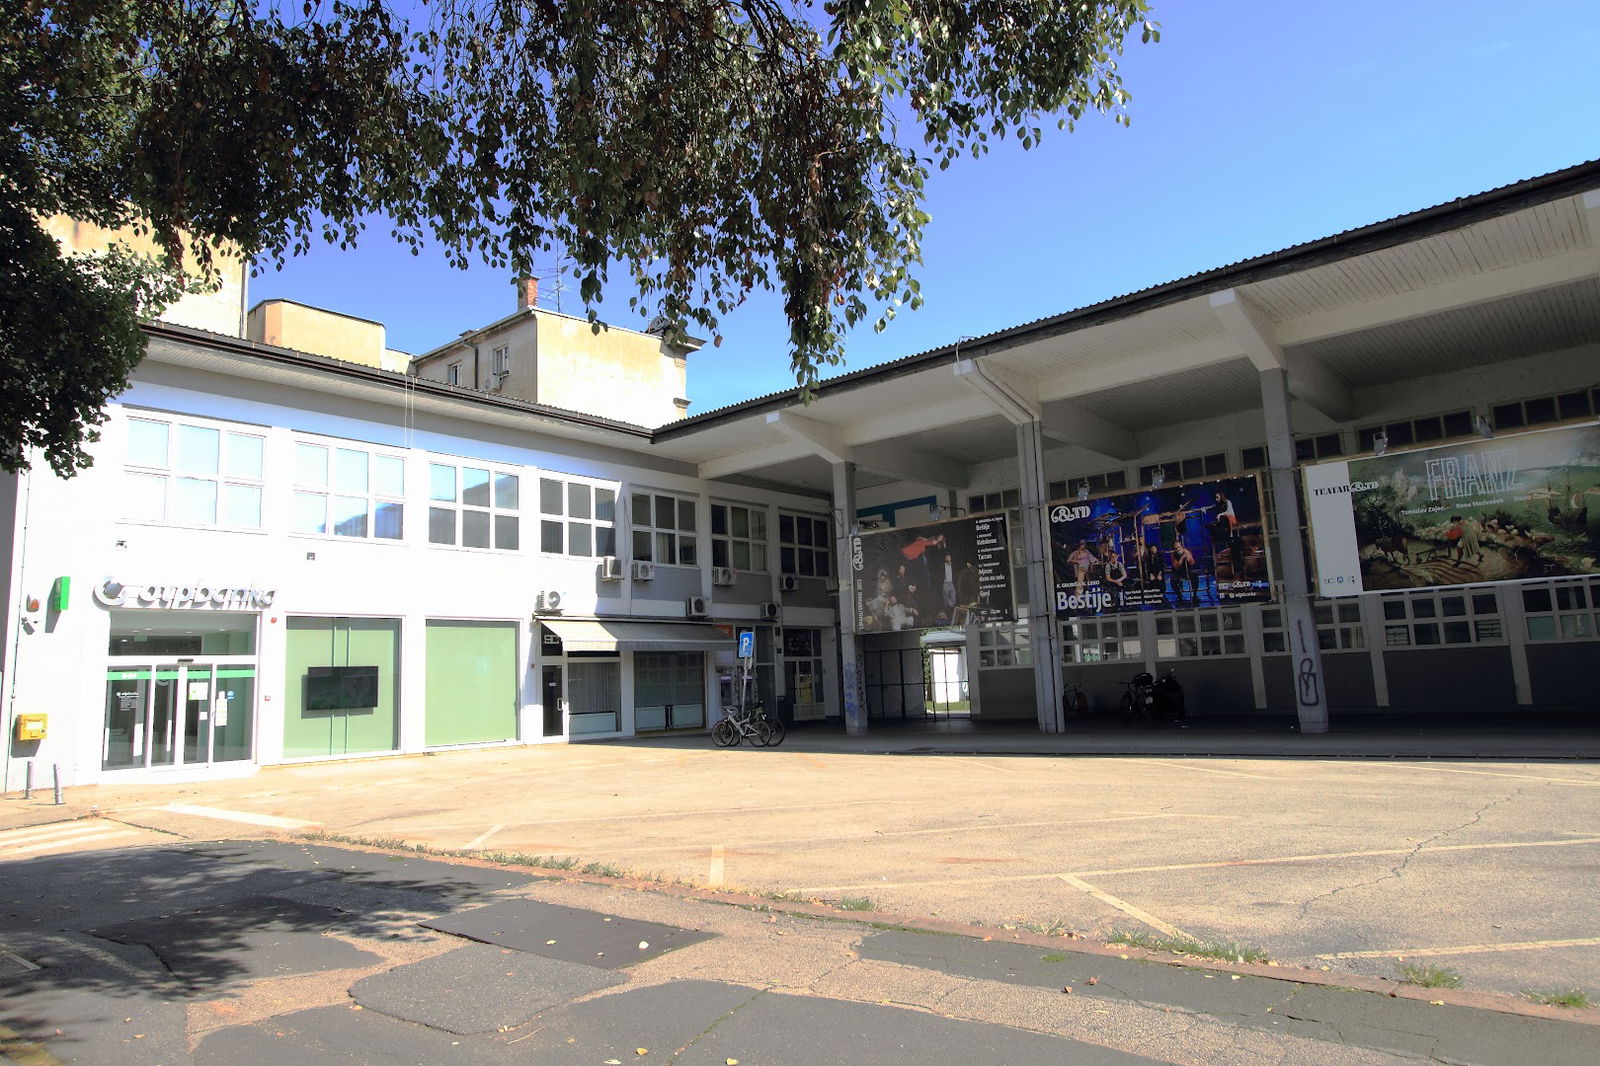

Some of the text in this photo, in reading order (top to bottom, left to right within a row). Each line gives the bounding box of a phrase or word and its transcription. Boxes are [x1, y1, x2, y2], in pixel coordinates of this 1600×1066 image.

[1424, 447, 1523, 501] FRANZ
[1313, 485, 1350, 496] TEATAR
[1051, 505, 1091, 523] &TD
[1057, 587, 1112, 613] Beštije
[742, 637, 750, 653] P
